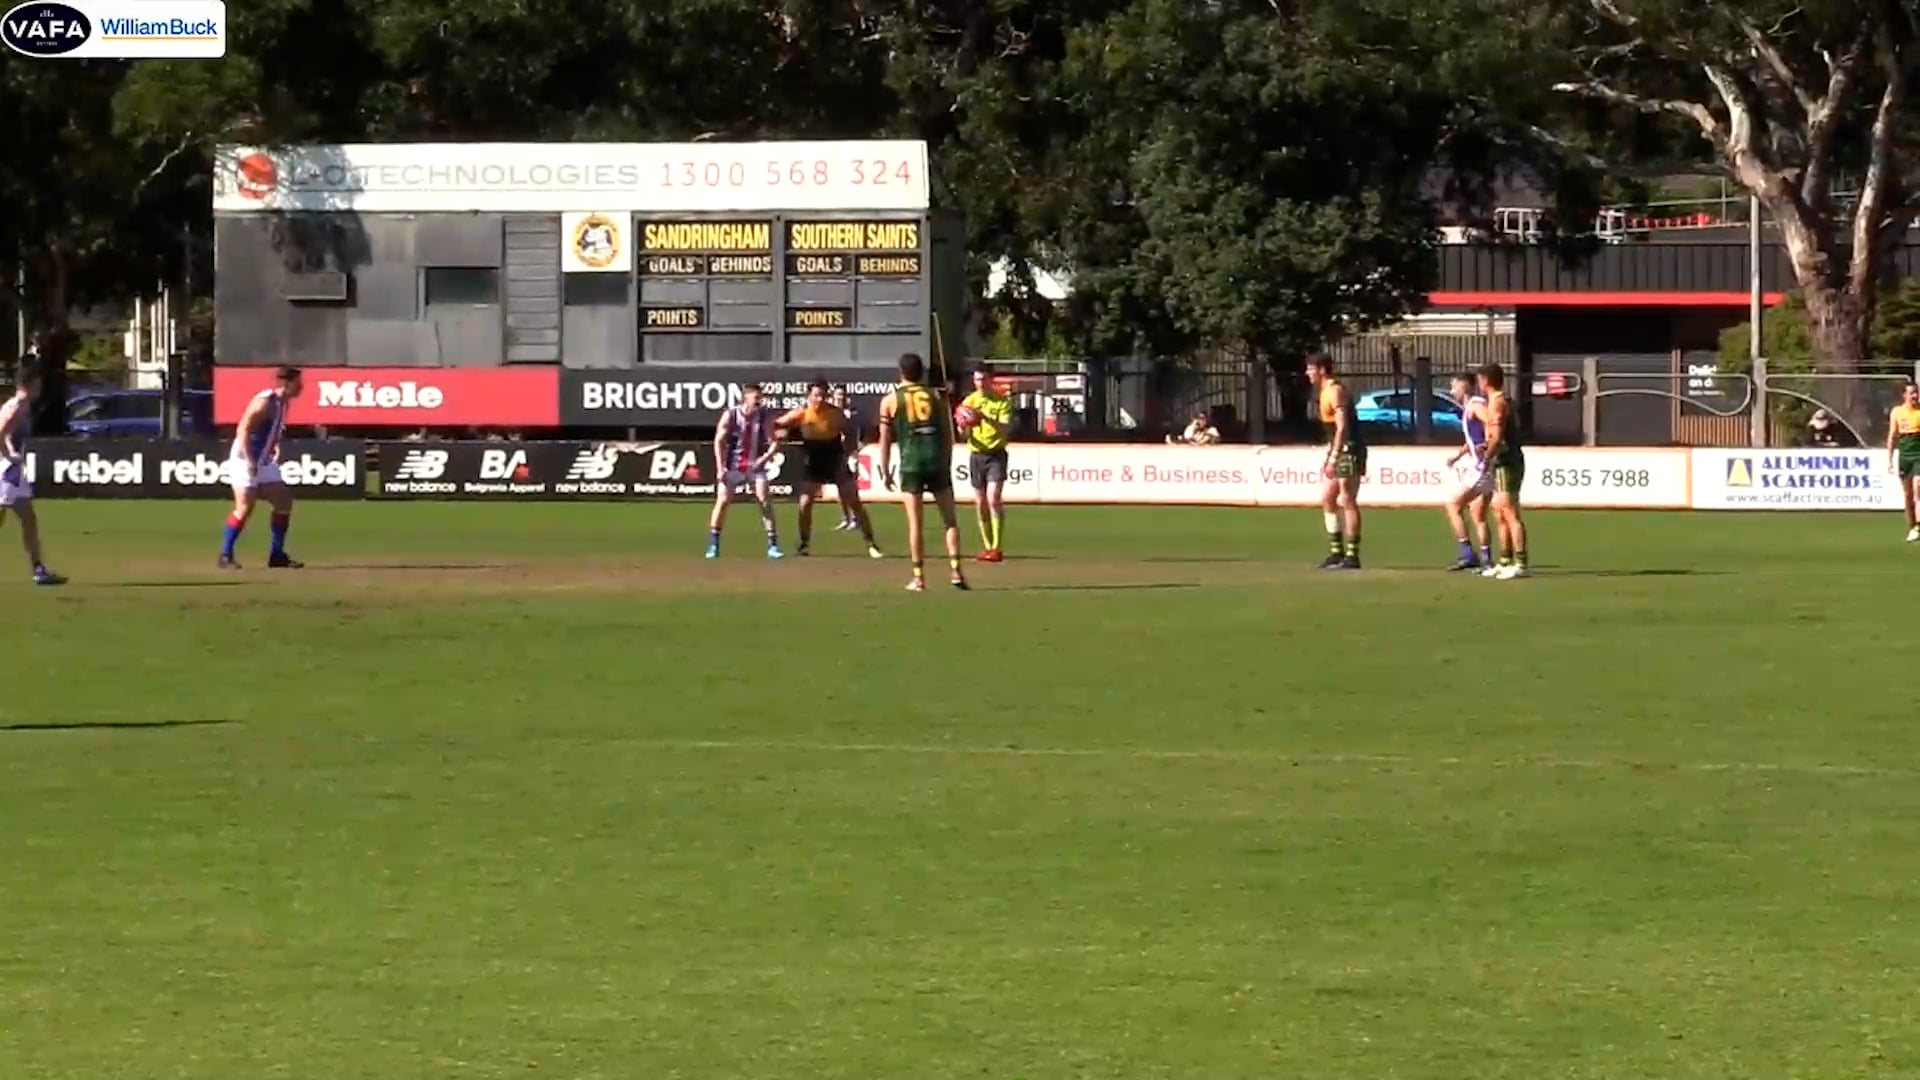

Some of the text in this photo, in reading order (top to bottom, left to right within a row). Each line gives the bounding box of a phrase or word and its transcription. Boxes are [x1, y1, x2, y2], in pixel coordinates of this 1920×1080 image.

[351, 164, 639, 187] TECHNOLOGIES
[660, 159, 912, 187] 1300 568 324
[645, 223, 770, 250] SANDRINGHAM
[791, 223, 918, 249] SOUTHERN SAINTS
[648, 257, 696, 273] GOALS
[710, 256, 772, 273] BEHINDS
[796, 257, 843, 273] GOALS
[859, 257, 919, 273] BEHINDS
[646, 309, 699, 326] POINTS
[794, 311, 844, 326] POINTS
[317, 380, 444, 409] Miele
[582, 381, 744, 410] BRIGHTON
[903, 390, 932, 422] 16
[53, 452, 144, 485] rebel
[279, 452, 356, 486] ebel
[1761, 455, 1871, 471] ALUMINIUM
[1051, 465, 1113, 484] Home
[1120, 466, 1135, 484] &
[1540, 468, 1651, 488] 8535 7988
[1760, 474, 1872, 489] SCAFFOLDS
[384, 481, 457, 493] new balance
[555, 482, 627, 493] new balance
